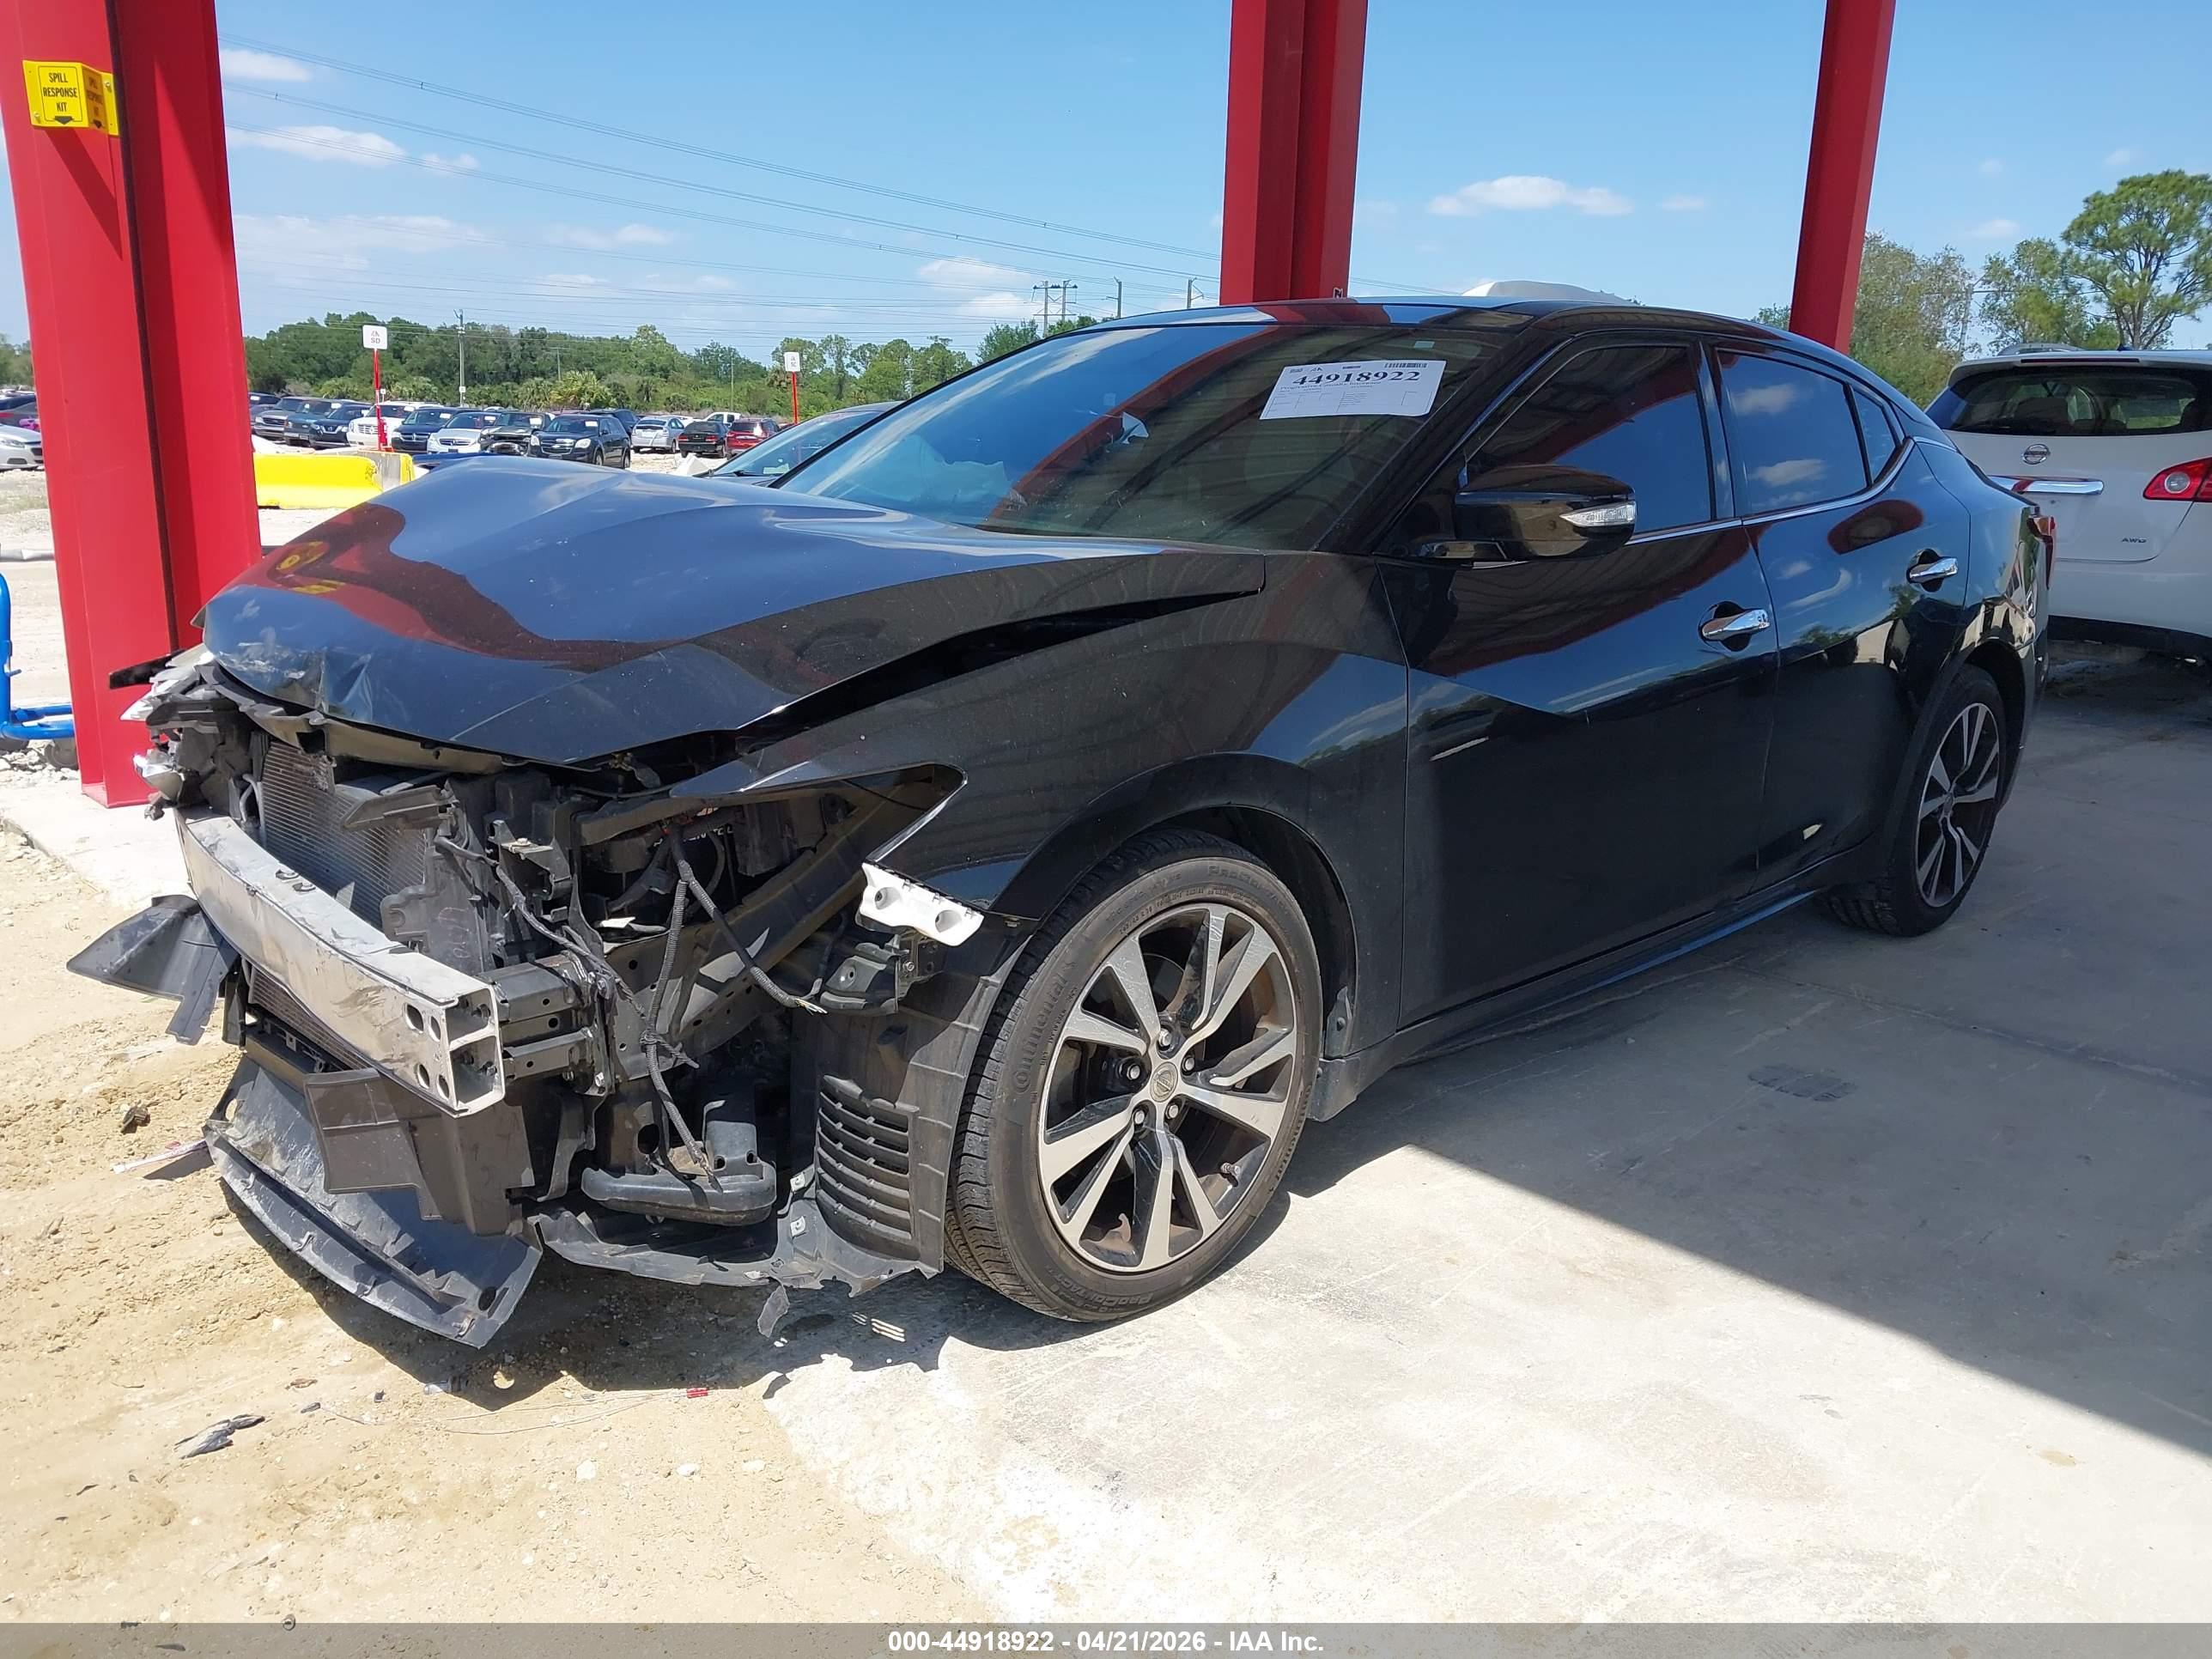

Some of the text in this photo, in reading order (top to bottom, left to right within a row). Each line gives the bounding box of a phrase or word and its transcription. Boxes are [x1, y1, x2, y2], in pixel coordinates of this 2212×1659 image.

[48, 72, 68, 82] SPILL
[43, 87, 77, 98] RESPONSE
[56, 102, 67, 112] KIT
[1292, 371, 1420, 386] 44918922
